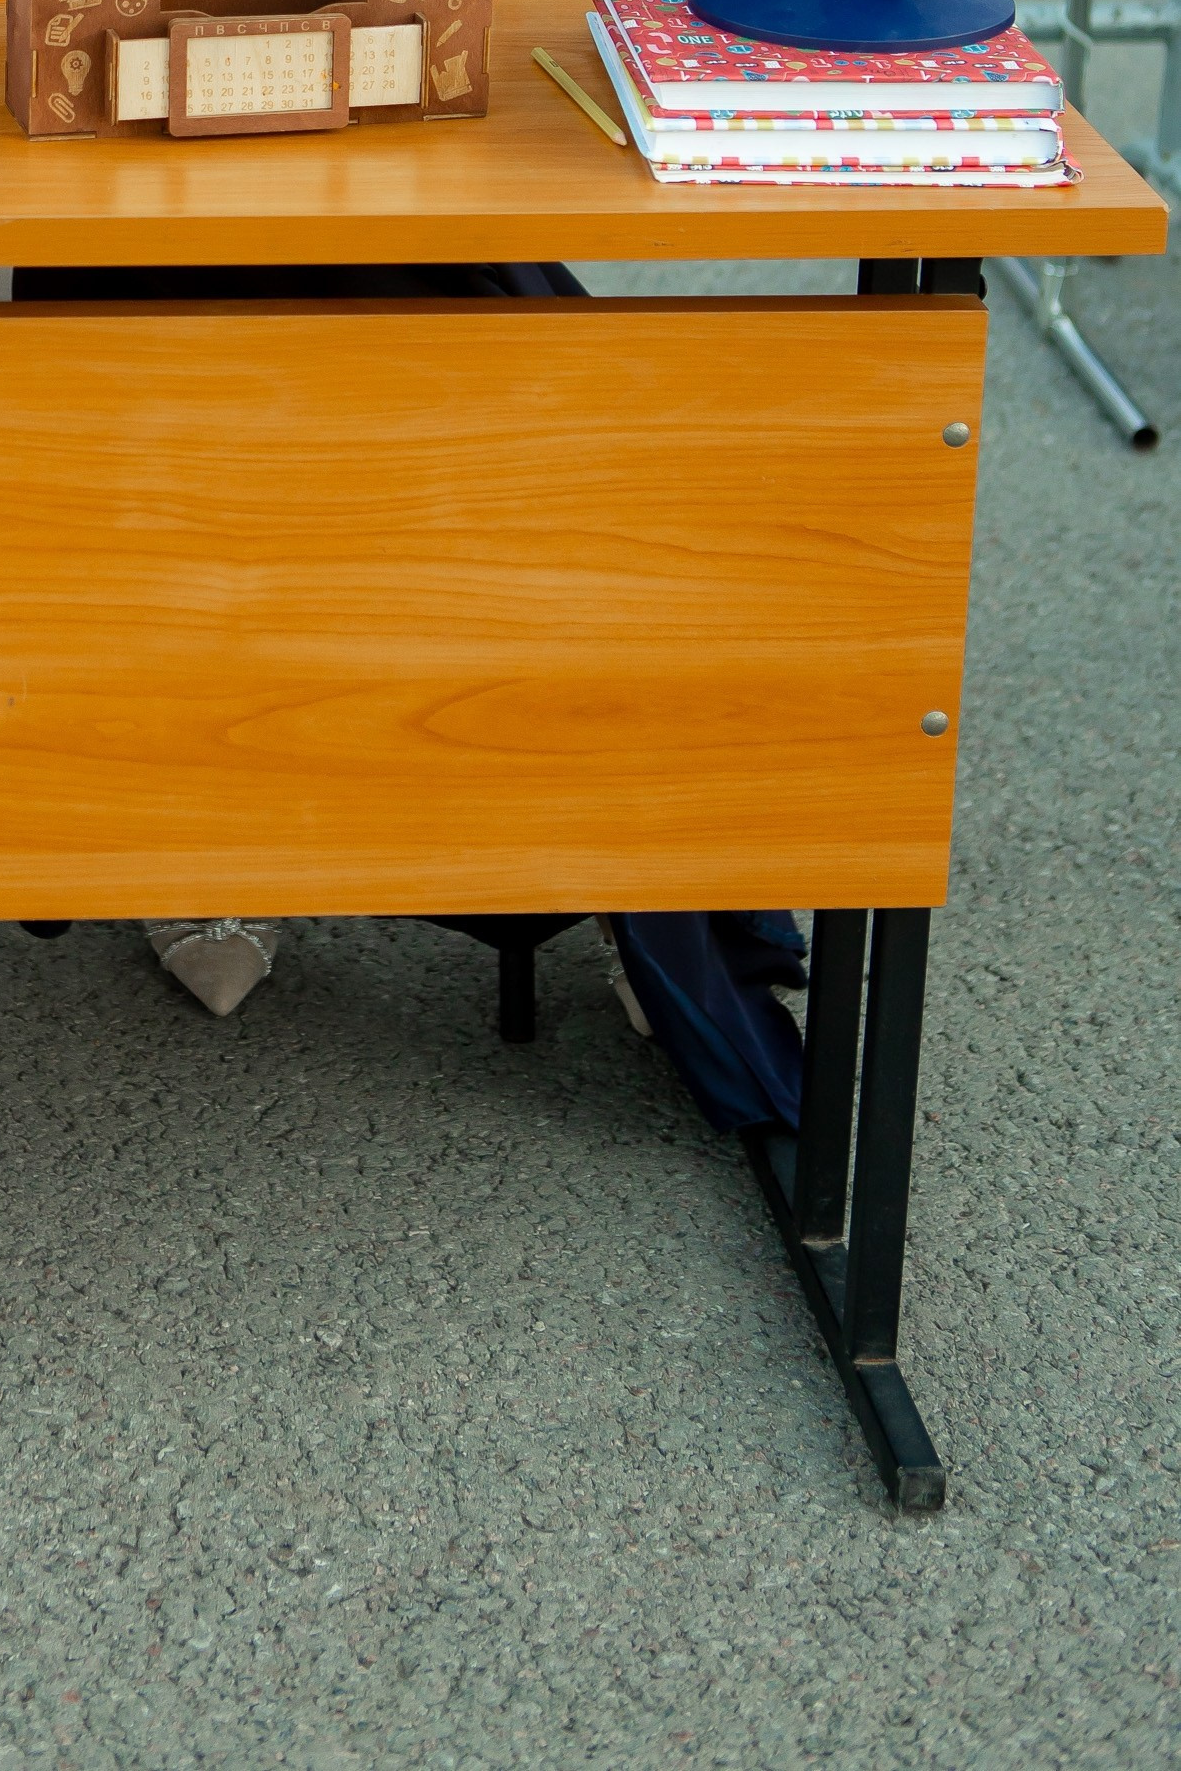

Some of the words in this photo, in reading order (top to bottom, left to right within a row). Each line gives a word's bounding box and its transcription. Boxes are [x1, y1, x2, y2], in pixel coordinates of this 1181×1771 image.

[195, 25, 204, 36] П
[280, 22, 289, 32] П
[285, 40, 292, 49] 2
[306, 38, 312, 48] 3
[367, 35, 374, 44] 6
[388, 33, 395, 42] 7
[677, 34, 715, 46] ONE
[364, 51, 376, 60] 13
[384, 49, 395, 58] 14
[144, 61, 150, 70] 2
[205, 59, 211, 67] 5
[225, 57, 231, 66] 6
[245, 57, 252, 65] 7
[265, 56, 272, 64] 8
[285, 55, 292, 63] 9
[303, 54, 315, 63] 10
[362, 66, 375, 75] 20
[383, 65, 395, 74] 21
[143, 76, 150, 86] 9
[202, 74, 213, 83] 12
[222, 73, 233, 82] 13
[242, 72, 253, 81] 14
[263, 71, 274, 80] 15
[282, 70, 294, 79] 16
[303, 69, 313, 78] 17
[202, 88, 213, 97] 19
[221, 87, 234, 97] 20
[242, 86, 254, 95] 21
[261, 85, 274, 96] 22
[282, 84, 294, 94] 23
[302, 83, 314, 93] 24
[362, 81, 375, 90] 27
[382, 80, 395, 89] 28
[141, 90, 153, 101] 16
[201, 103, 213, 113] 26
[221, 102, 234, 112] 27
[241, 102, 254, 111] 28
[261, 101, 274, 110] 29
[281, 100, 294, 109] 30
[302, 99, 314, 108] 31
